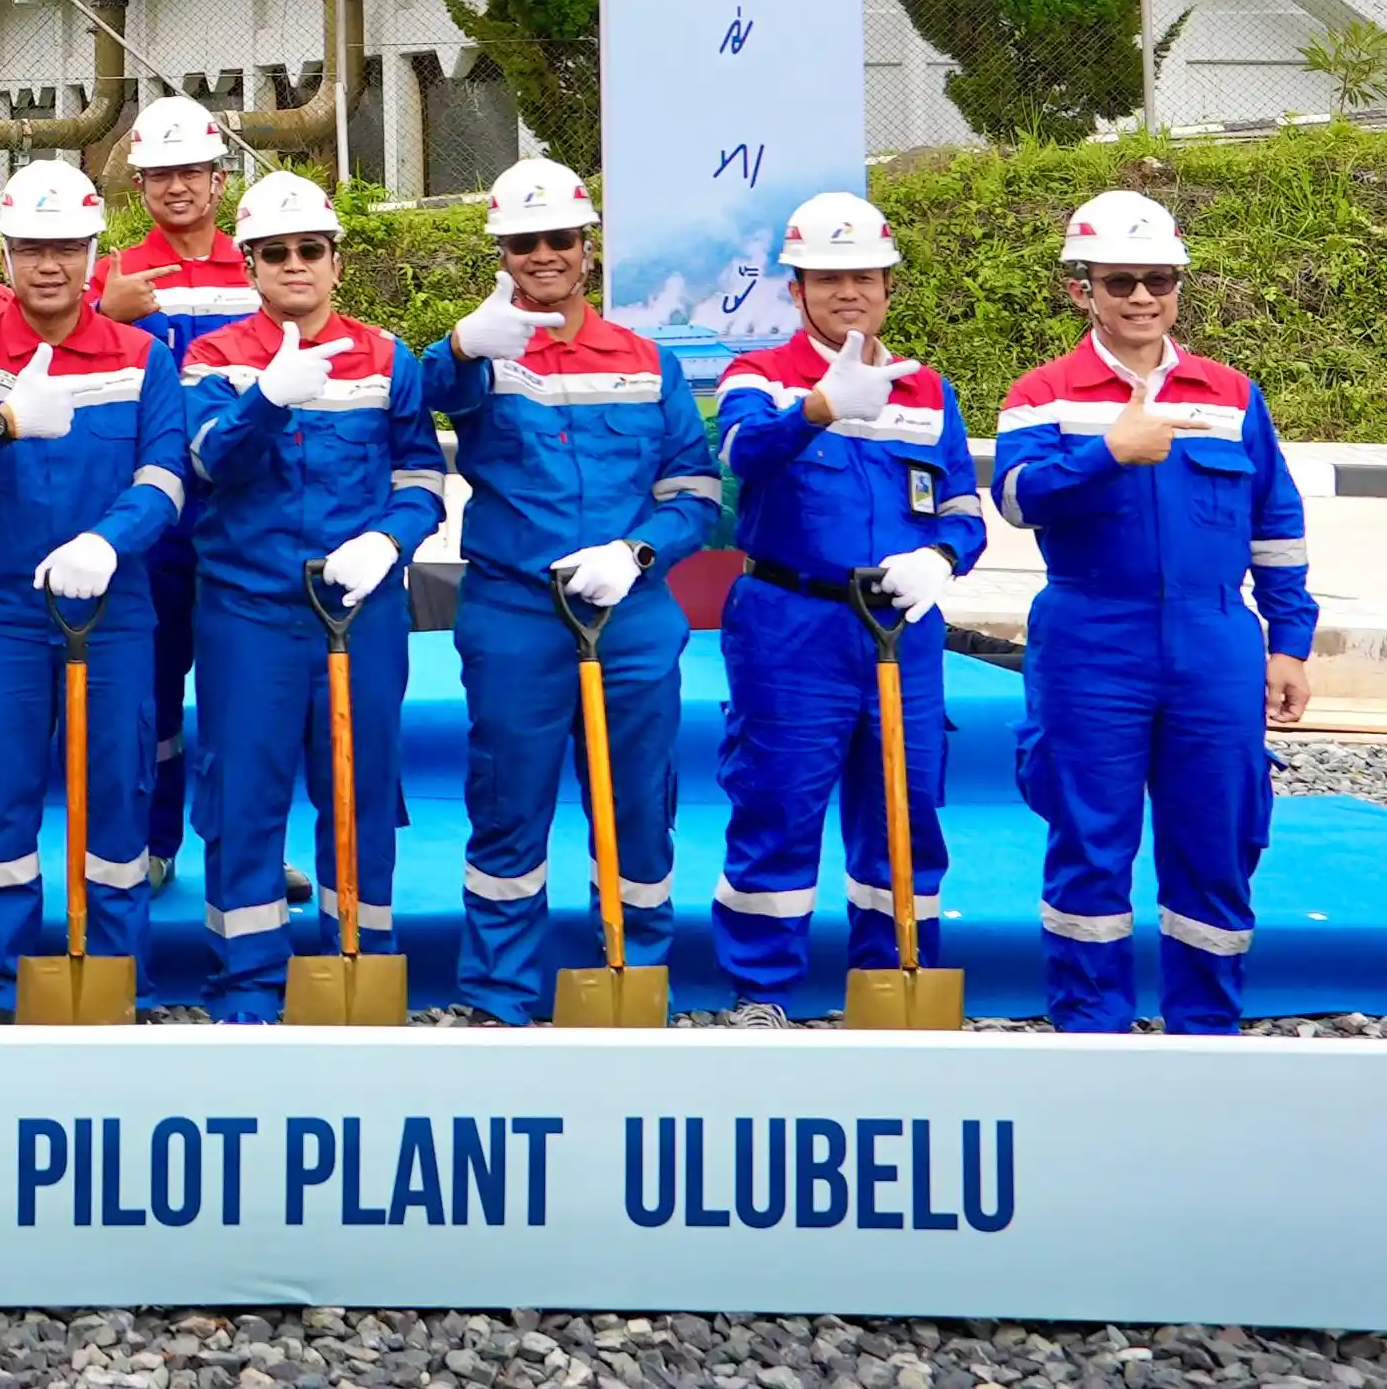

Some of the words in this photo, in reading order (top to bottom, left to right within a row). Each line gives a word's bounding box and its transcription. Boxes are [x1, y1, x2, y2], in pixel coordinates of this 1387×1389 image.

[16, 1116, 258, 1228] PILOT
[284, 1116, 564, 1228] PLANT
[624, 1116, 1015, 1233] ULUBELU
